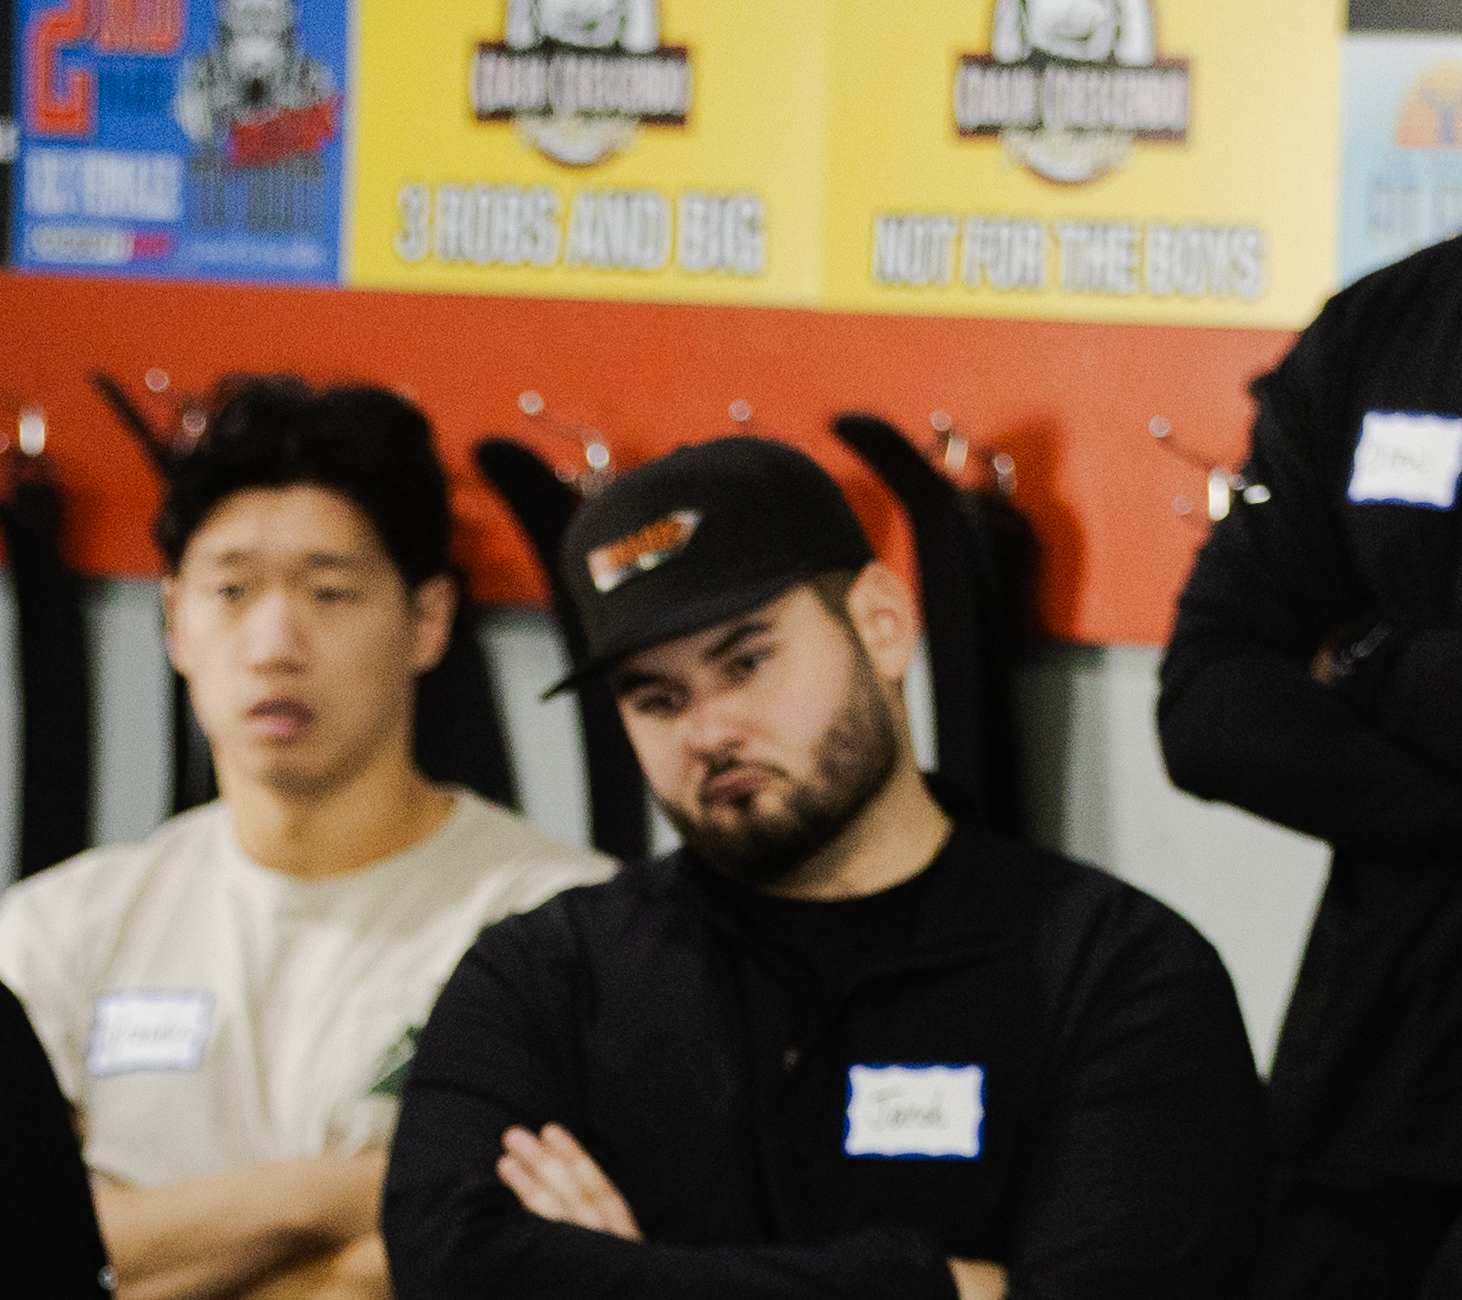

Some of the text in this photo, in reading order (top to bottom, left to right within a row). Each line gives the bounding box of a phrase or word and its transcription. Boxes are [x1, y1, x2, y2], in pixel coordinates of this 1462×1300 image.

[565, 189, 674, 271] AND
[676, 191, 766, 275] BIG
[875, 211, 1270, 299] NOT FOR THE BOYS
